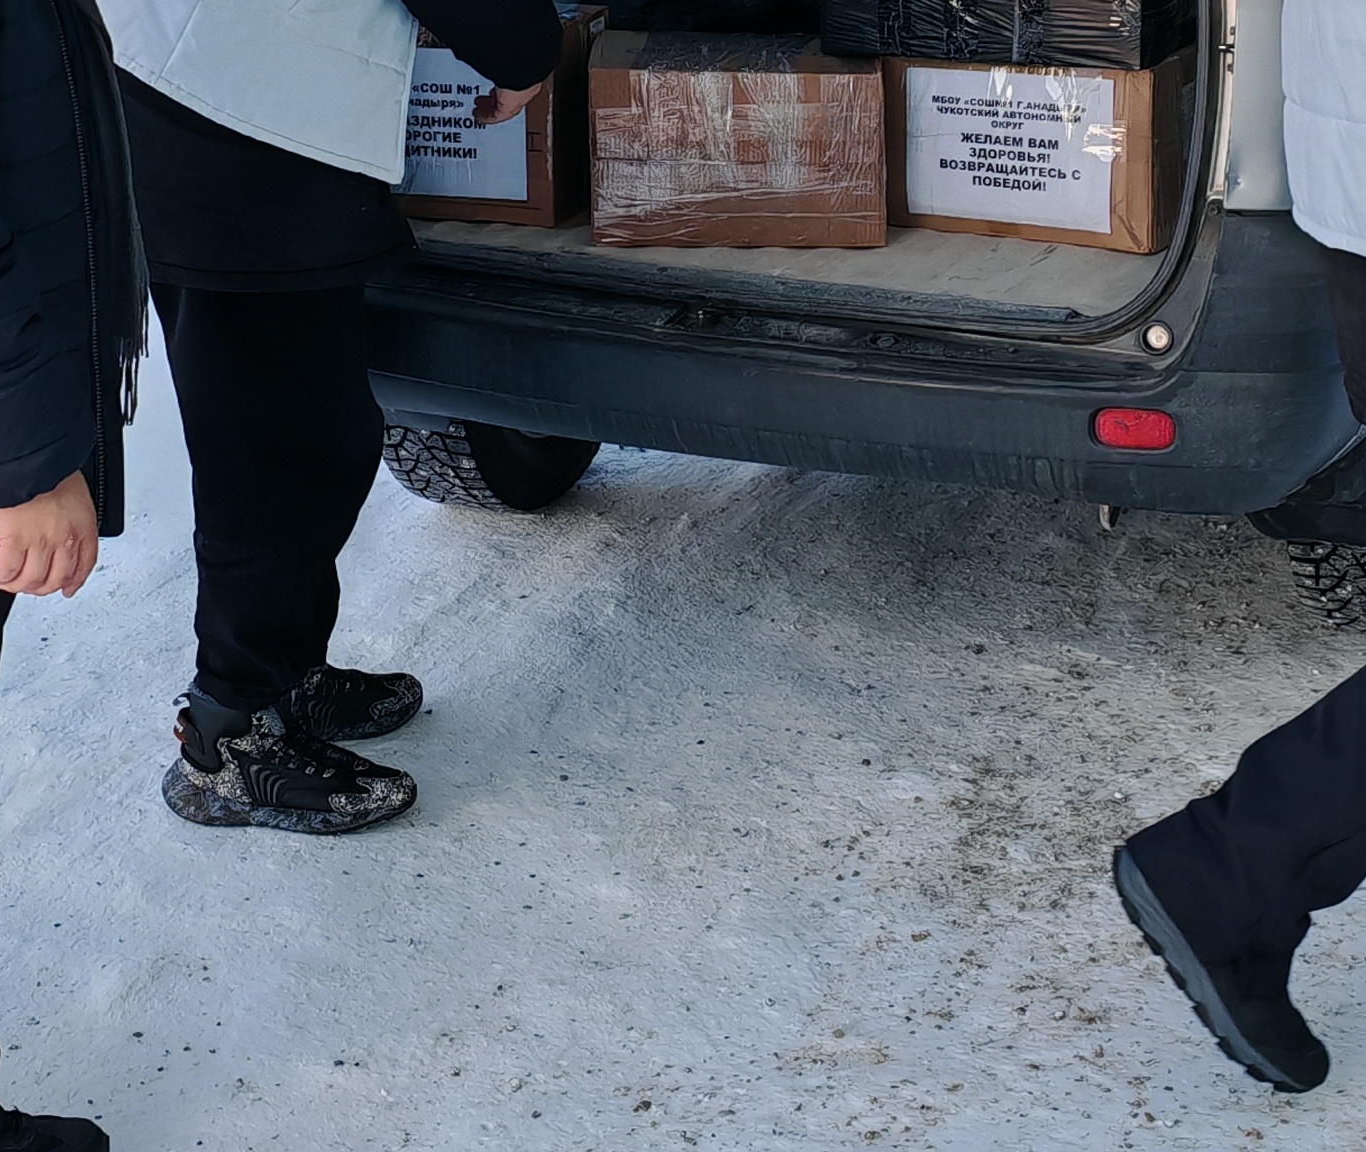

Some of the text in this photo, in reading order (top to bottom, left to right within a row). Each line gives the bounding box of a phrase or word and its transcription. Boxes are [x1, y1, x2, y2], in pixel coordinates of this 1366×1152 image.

[932, 95, 961, 106] МБОУ
[937, 105, 1000, 119] ЧУКОТСКИЙ
[407, 115, 486, 130] ЗДНИКОМ
[991, 120, 1024, 131] ОКРУГ
[960, 132, 1059, 151] ЖЕЛАЕМ ВАМ
[969, 147, 1051, 164] ЗДОРОВЬЯ!
[939, 159, 1082, 181] ВОЗВРАЩАЙТЕСЬ С
[972, 175, 1047, 192] ПОБЕДОЙ!
